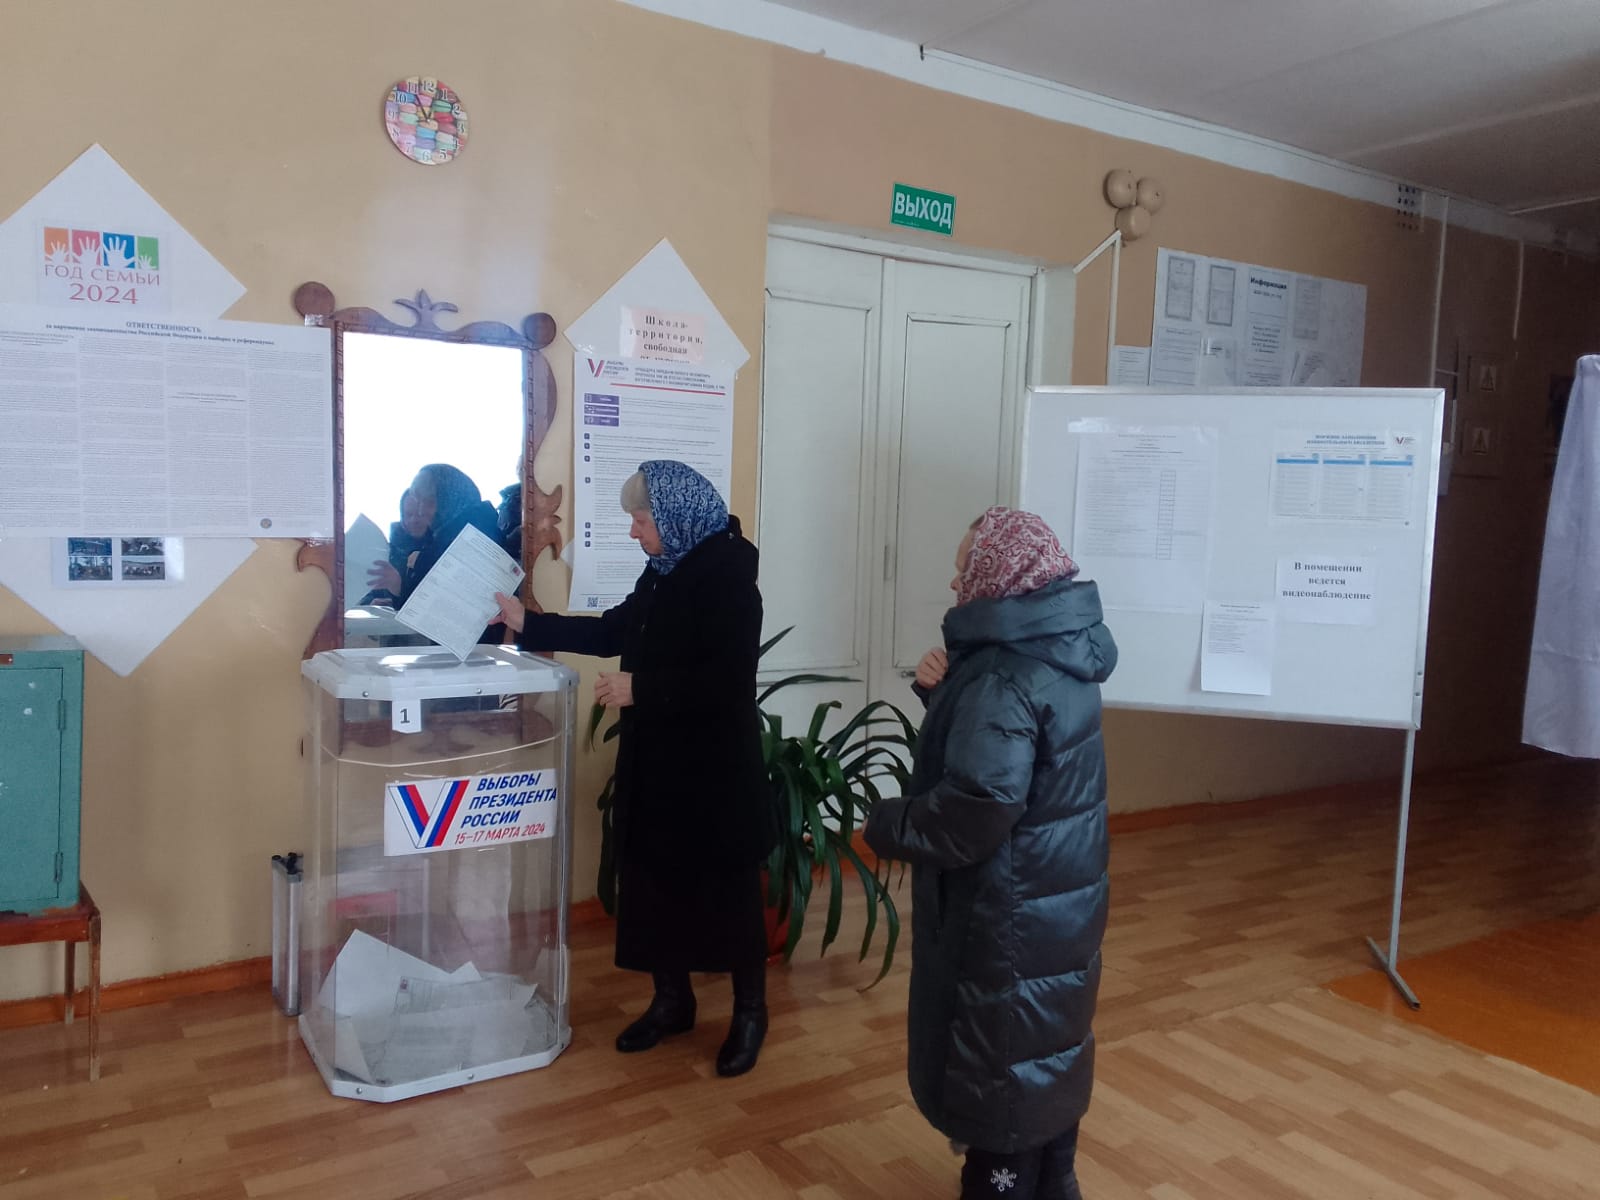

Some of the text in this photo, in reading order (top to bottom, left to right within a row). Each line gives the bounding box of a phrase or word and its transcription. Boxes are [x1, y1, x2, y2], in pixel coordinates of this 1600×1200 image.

[408, 82, 417, 94] 11
[423, 80, 435, 93] 12
[396, 91, 407, 104] 10
[453, 103, 461, 115] 2
[440, 148, 448, 160] 5
[894, 192, 952, 229] ВЫХОД
[44, 264, 160, 287] ГОД СЕМЬИ
[69, 283, 139, 305] 2024
[643, 343, 688, 354] свободная
[1294, 562, 1362, 573] В помещении
[1308, 577, 1346, 586] ведется
[1282, 590, 1372, 600] видеонаблюдение
[400, 709, 410, 724] 1
[476, 773, 542, 791] ВЫБОРЫ
[469, 788, 557, 810] ПРЕЗИДЕНТА
[461, 810, 521, 829] РОССИИ
[485, 827, 520, 841] МАРТА
[521, 823, 545, 837] 2024
